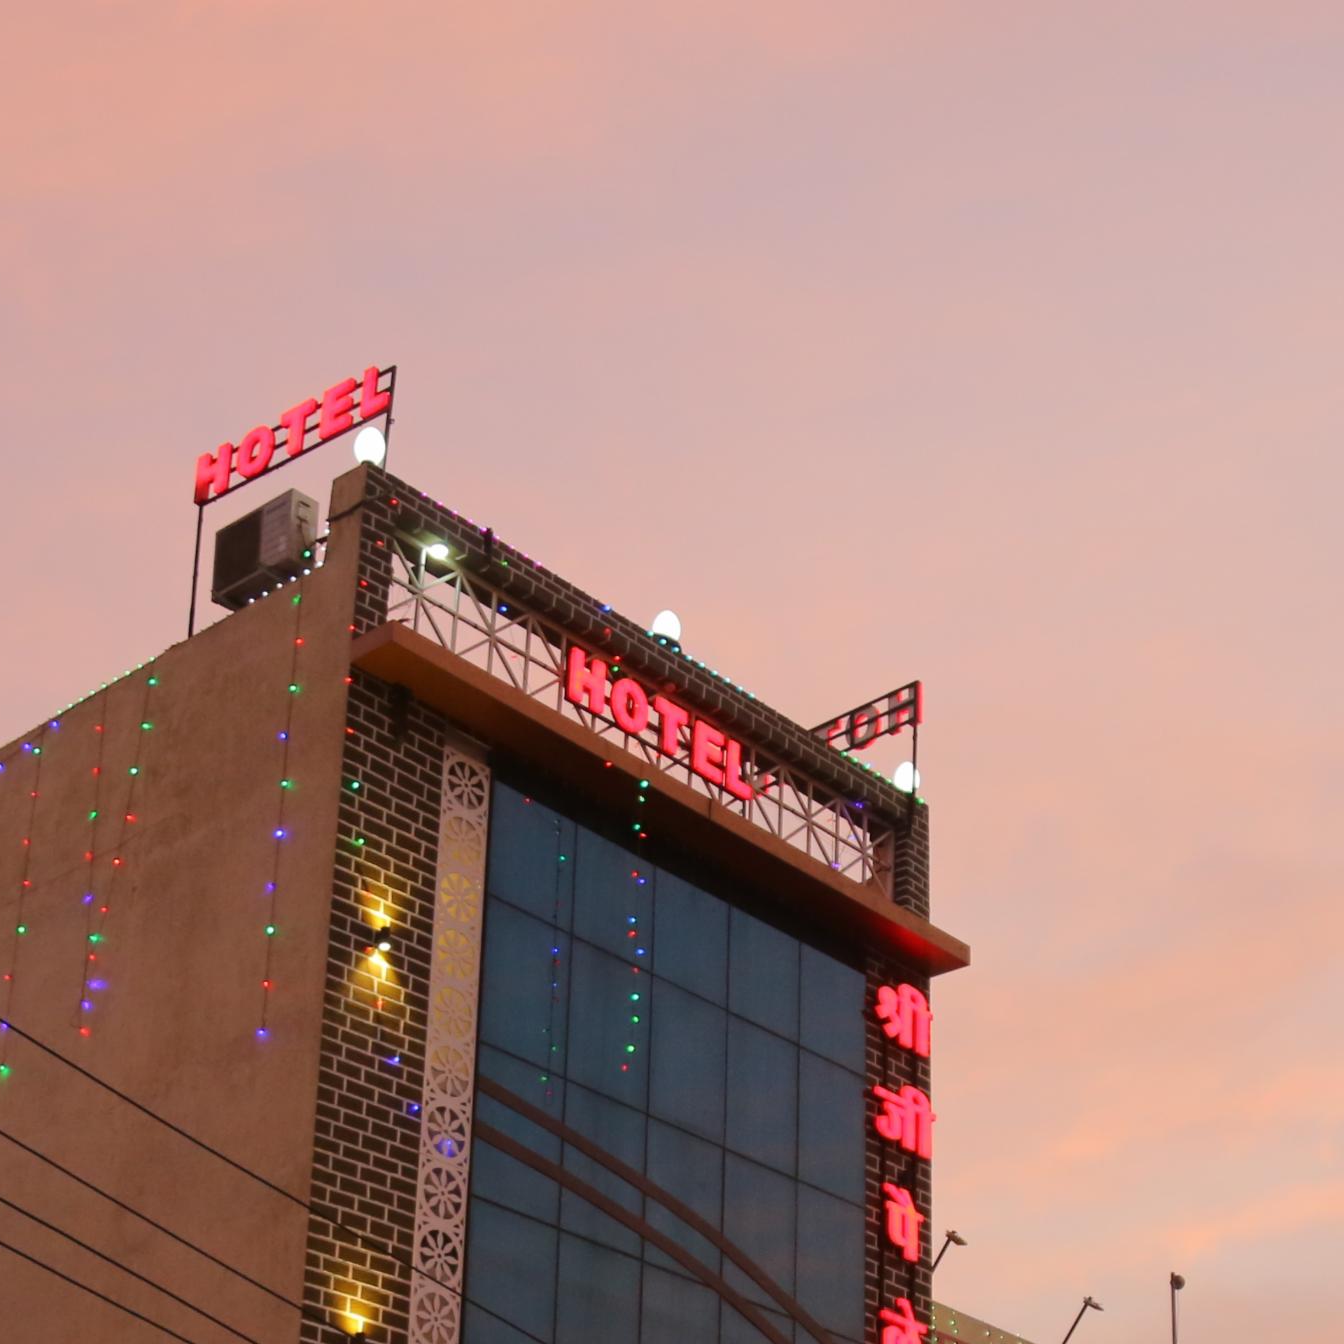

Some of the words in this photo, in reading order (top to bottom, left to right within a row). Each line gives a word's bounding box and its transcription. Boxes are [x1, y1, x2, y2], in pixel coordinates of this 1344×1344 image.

[194, 365, 392, 505] HOTEL
[564, 645, 754, 802] HOTEL
[874, 982, 933, 1058] श्री
[872, 1084, 936, 1160] जी
